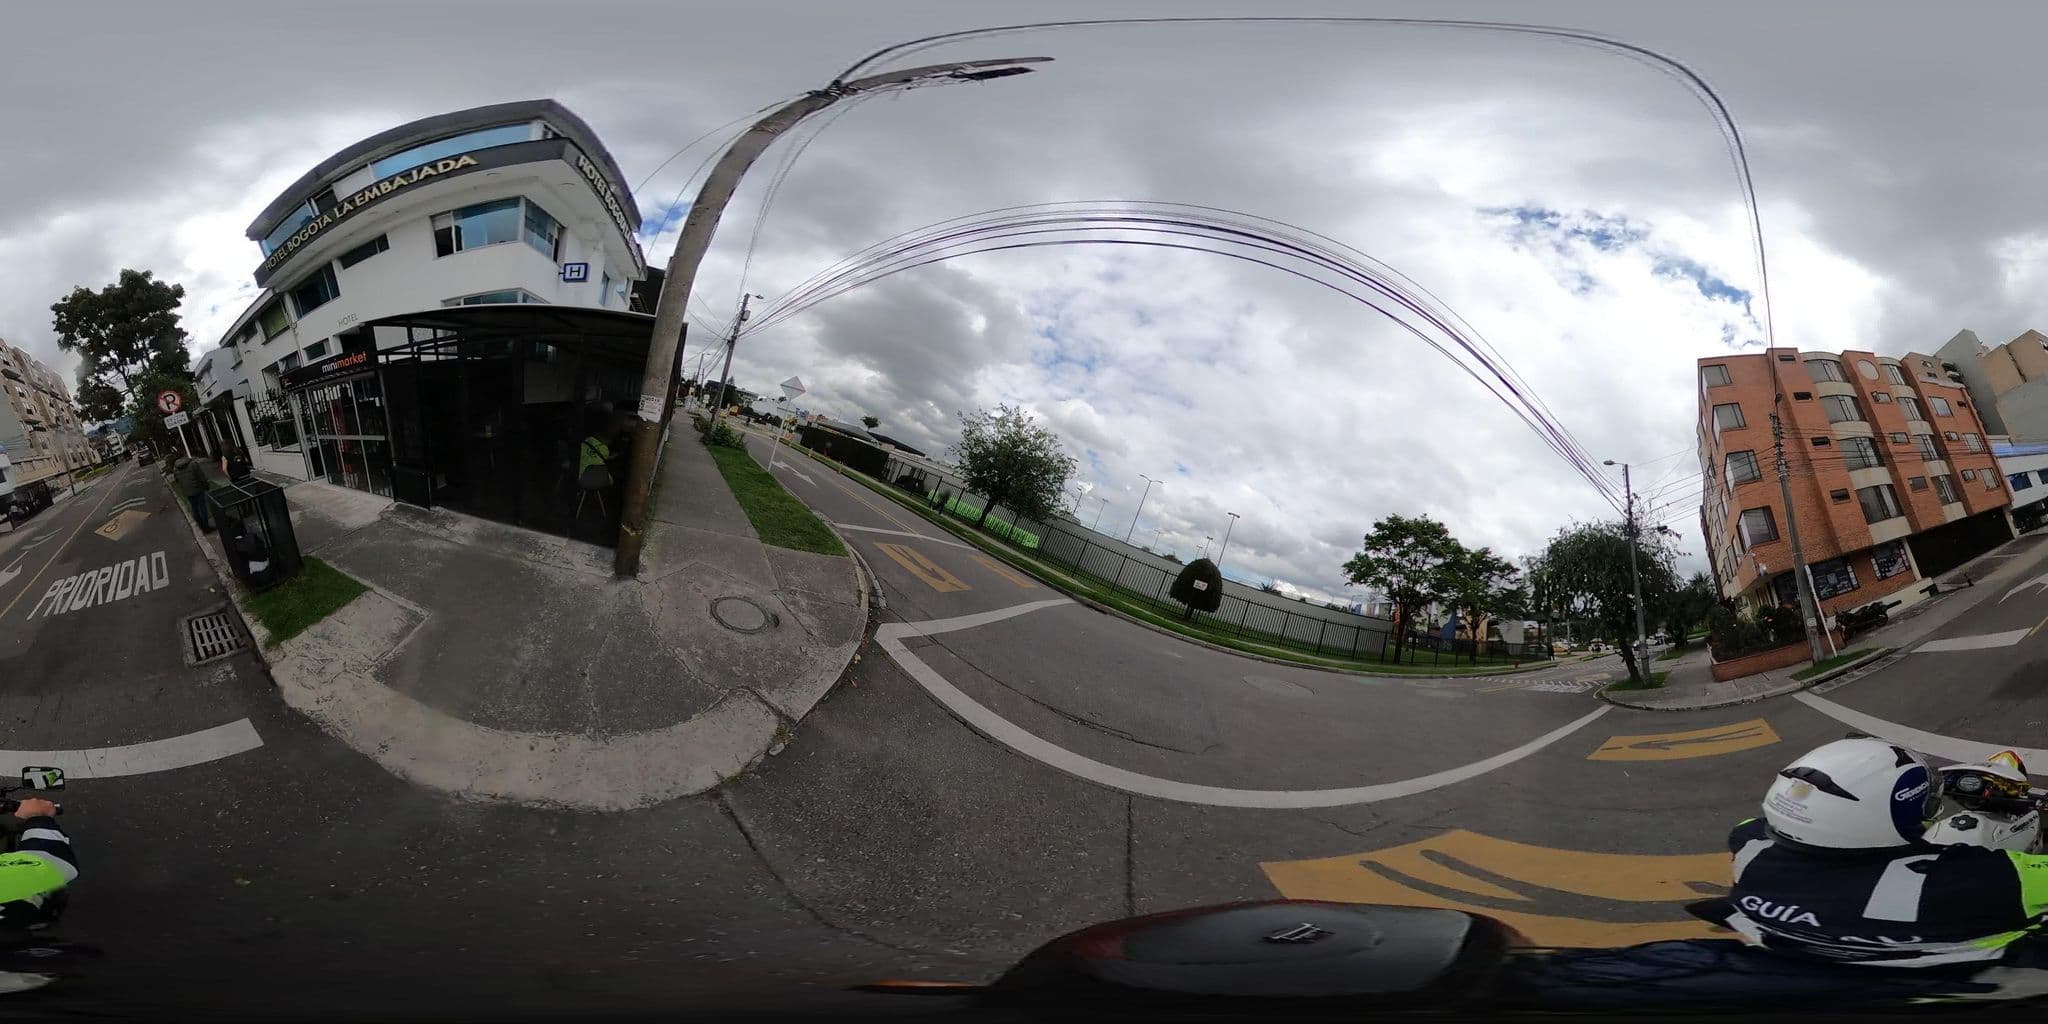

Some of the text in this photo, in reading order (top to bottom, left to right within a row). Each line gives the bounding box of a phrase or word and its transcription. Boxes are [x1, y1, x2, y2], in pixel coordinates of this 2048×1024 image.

[264, 154, 479, 271] HOTEL BOGOTA LA EMBAJADA
[569, 266, 581, 277] H
[337, 312, 359, 328] HOTEL
[321, 351, 368, 373] minimarket
[26, 550, 170, 620] PRIORIDAD
